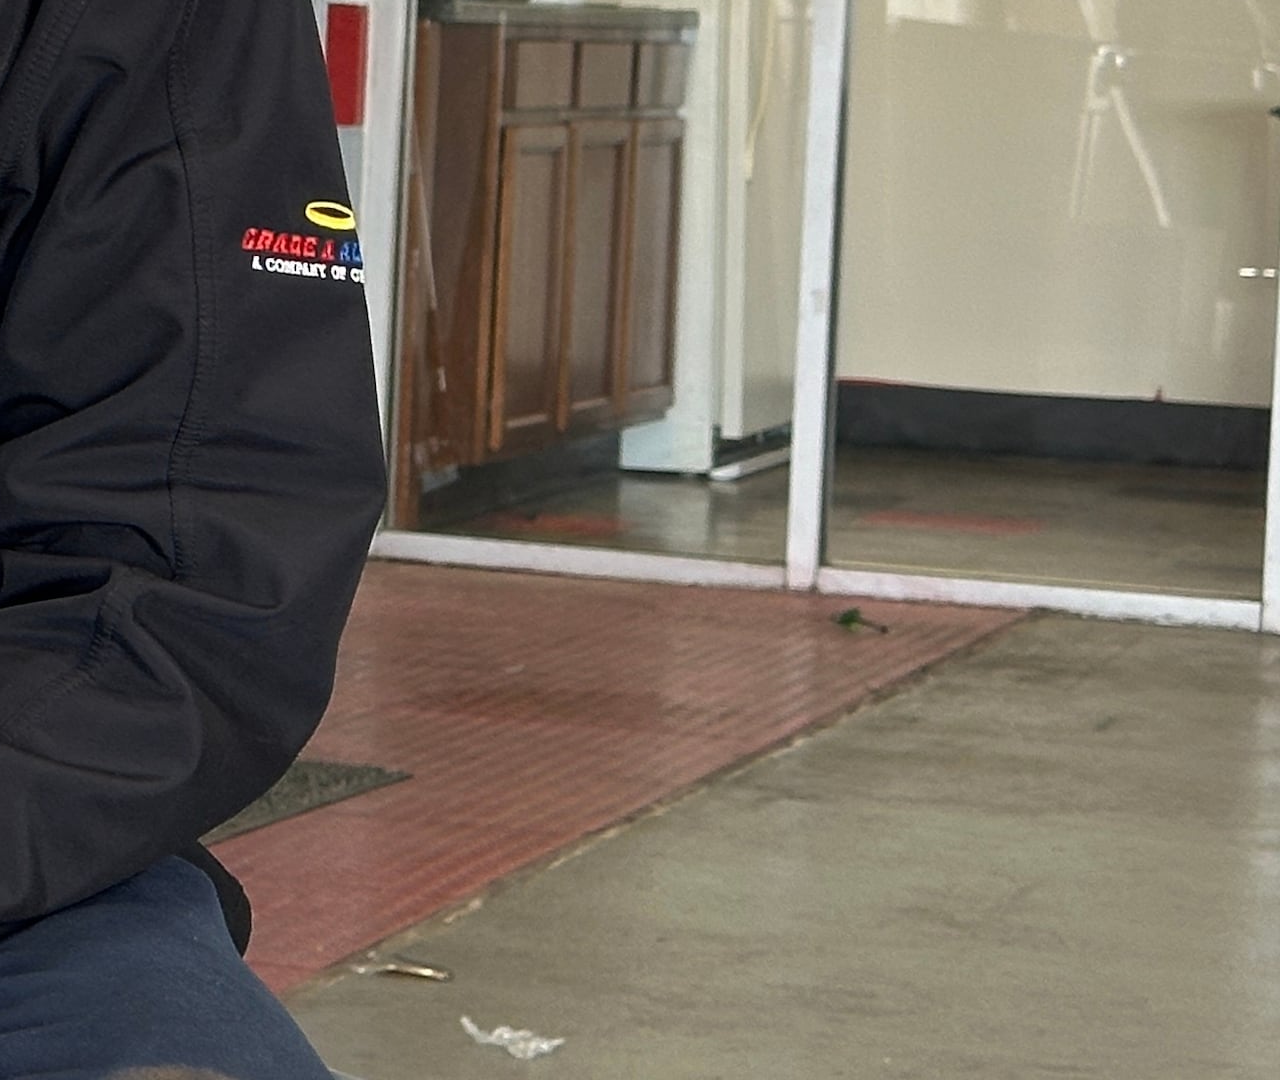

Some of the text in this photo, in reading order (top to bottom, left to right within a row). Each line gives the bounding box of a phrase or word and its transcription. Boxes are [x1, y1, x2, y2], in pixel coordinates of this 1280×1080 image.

[252, 255, 263, 270] A
[265, 257, 326, 278] COMPANY
[330, 265, 346, 280] OF
